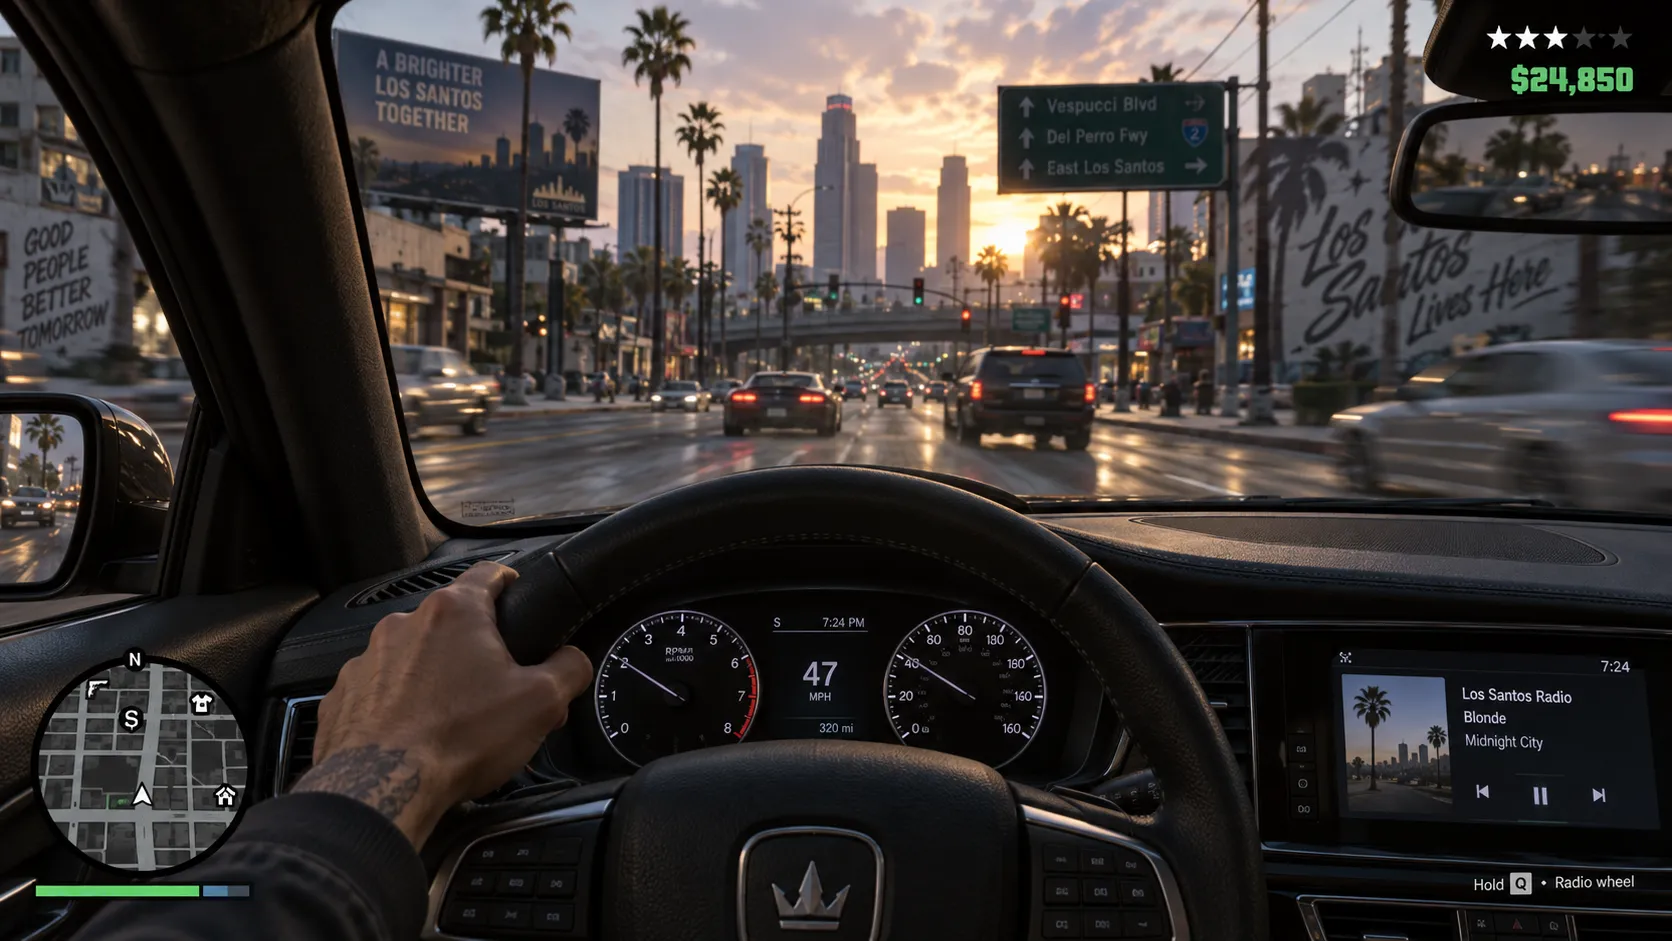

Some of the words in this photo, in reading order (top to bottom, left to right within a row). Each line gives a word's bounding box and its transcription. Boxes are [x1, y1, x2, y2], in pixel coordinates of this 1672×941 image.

[376, 49, 390, 70] A
[395, 53, 483, 86] BRIGHTER
[375, 75, 411, 100] LOS
[416, 82, 483, 111] SANTOS
[1047, 98, 1118, 117] Vespucci
[1123, 96, 1157, 112] Blvd
[375, 101, 469, 133] TOGETHER
[1047, 129, 1071, 144] Del
[1076, 129, 1115, 144] Perro
[1120, 128, 1148, 146] Fwy
[1190, 127, 1200, 141] 2
[1047, 160, 1078, 175] East
[1084, 159, 1109, 174] Los
[1114, 158, 1165, 174] Santos
[532, 199, 549, 209] LOS
[551, 201, 586, 214] SANTOS
[24, 220, 75, 257] GOOD
[1299, 206, 1374, 288] Los
[23, 245, 90, 289] PEOPLE
[21, 276, 92, 322] BETTER
[1406, 284, 1474, 346] Lives
[1479, 255, 1554, 314] Here
[17, 301, 110, 350] TOMORROW
[773, 617, 781, 628] S
[822, 617, 845, 628] 7:24
[848, 617, 865, 628] PM
[676, 625, 686, 636] 4
[957, 625, 973, 636] 80
[644, 634, 653, 645] 3
[709, 635, 718, 645] 5
[731, 658, 739, 669] 6
[1600, 660, 1631, 674] 7:24
[802, 661, 838, 686] 47
[611, 690, 616, 701] 1
[738, 690, 746, 701] 7
[809, 692, 832, 701] MPH
[899, 690, 914, 701] 20
[1462, 687, 1485, 701] Los
[1488, 688, 1532, 703] Santos
[1536, 689, 1572, 704] Radio
[1463, 710, 1507, 725] Blonde
[620, 722, 629, 733] 0
[724, 722, 732, 733] 8
[819, 723, 839, 733] 320
[841, 723, 854, 733] mi
[912, 723, 920, 734] 0
[1002, 723, 1021, 734] 160
[1465, 734, 1517, 751] Midnight
[1520, 735, 1544, 752] City
